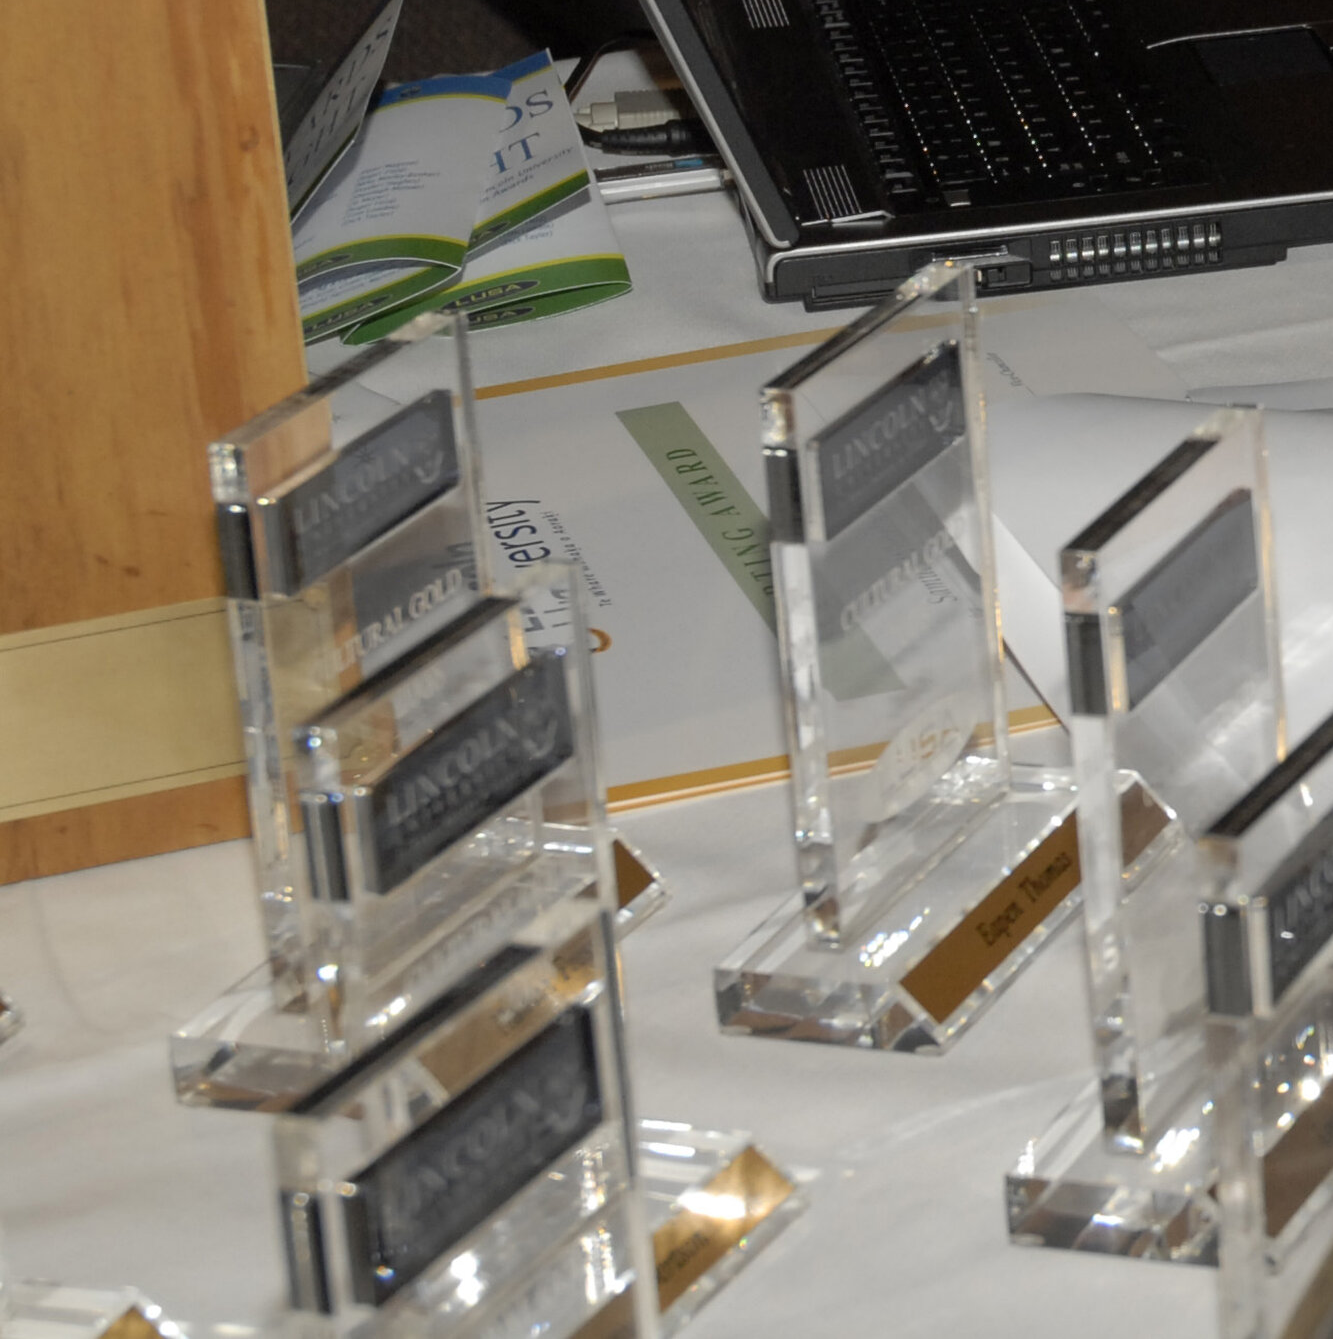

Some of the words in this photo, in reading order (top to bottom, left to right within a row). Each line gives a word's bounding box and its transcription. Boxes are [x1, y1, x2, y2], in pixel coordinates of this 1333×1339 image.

[455, 283, 523, 308] LUSA
[666, 448, 741, 517] AWARD
[407, 566, 464, 621] GOLD
